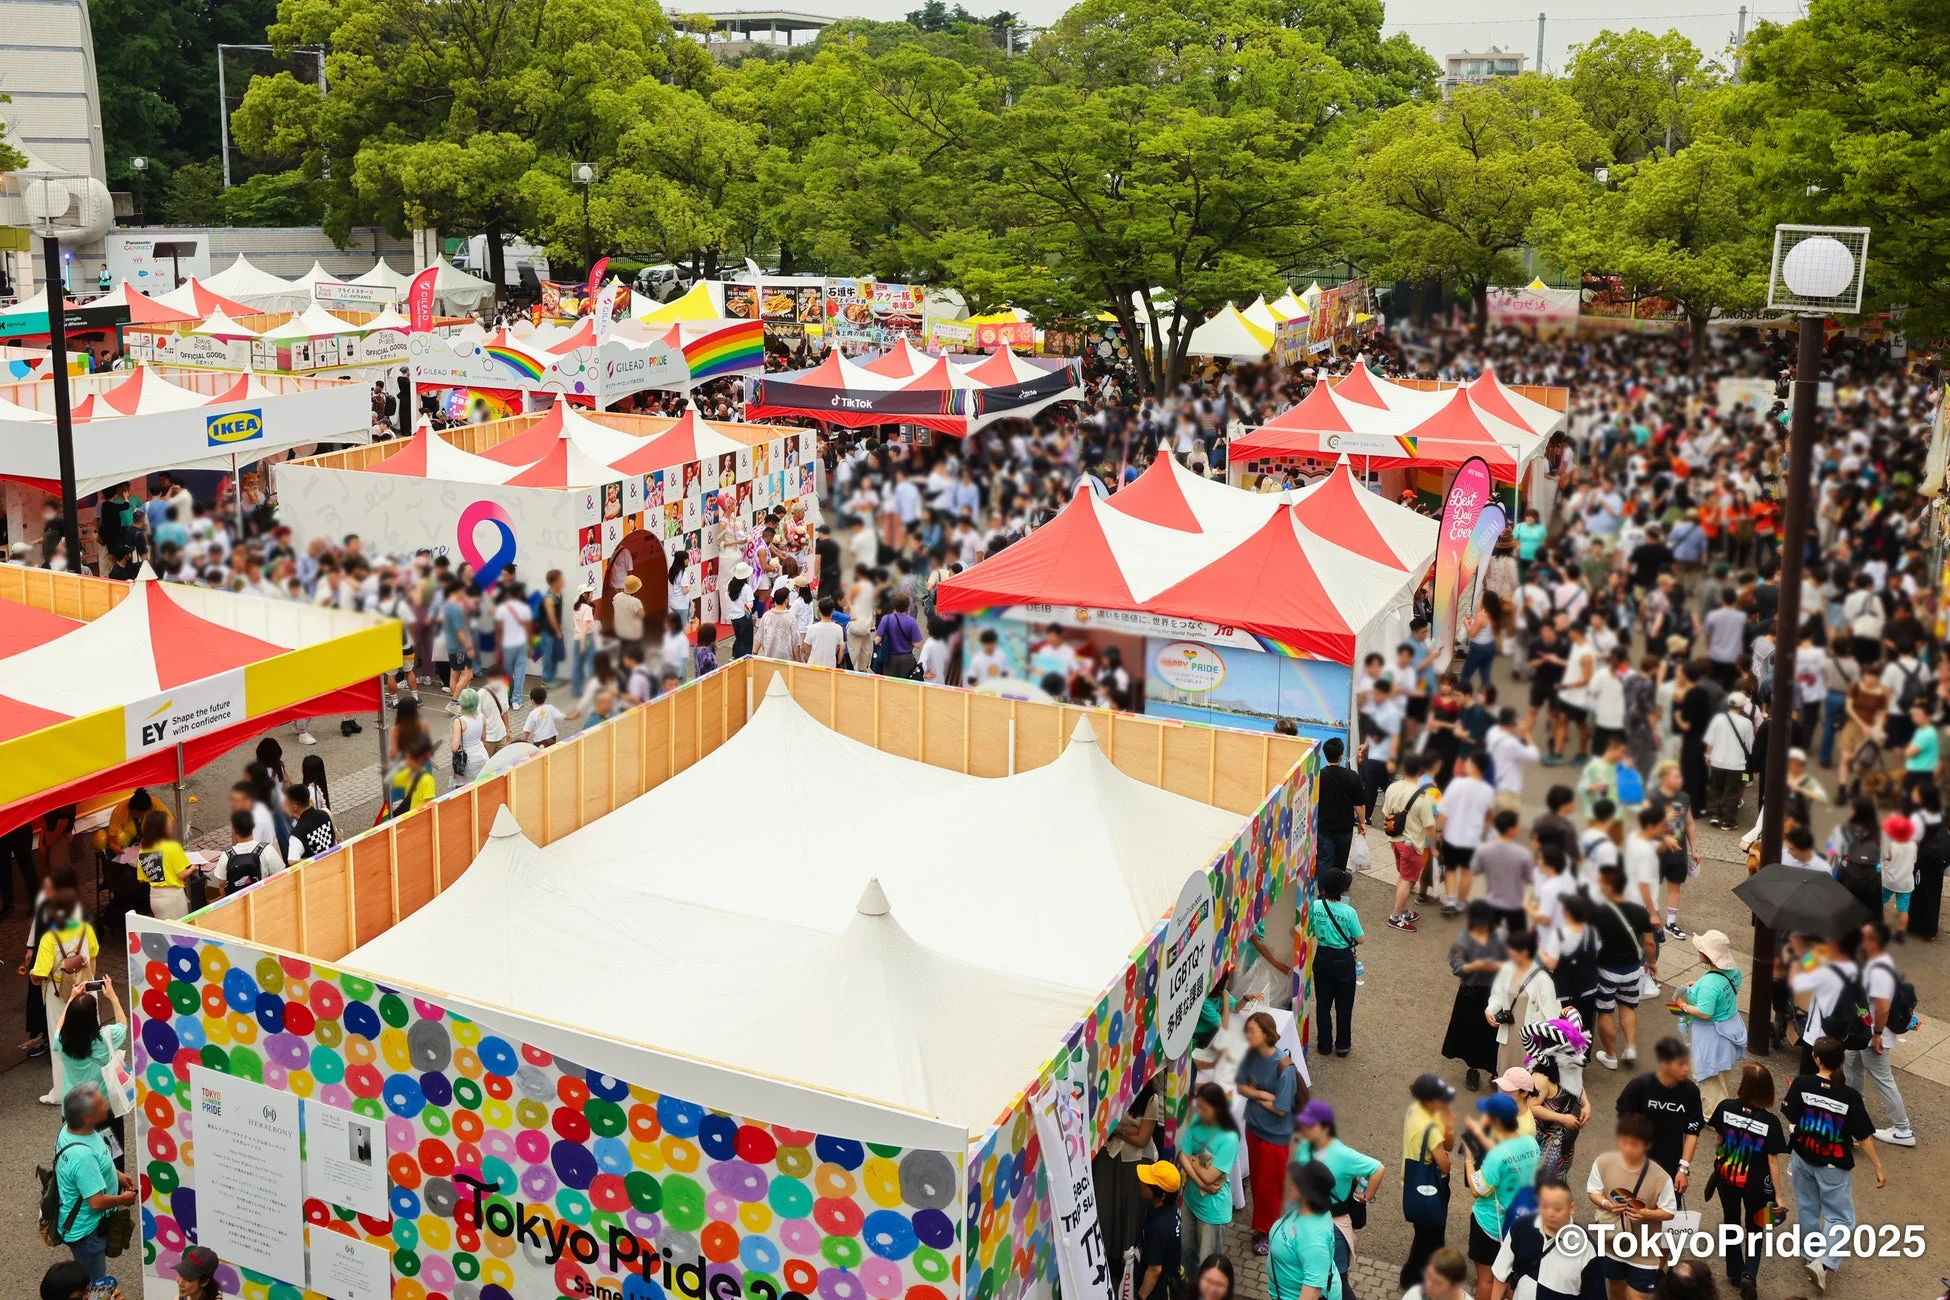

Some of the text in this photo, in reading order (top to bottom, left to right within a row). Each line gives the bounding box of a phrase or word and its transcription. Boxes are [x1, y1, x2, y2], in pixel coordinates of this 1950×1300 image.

[420, 292, 430, 321] GILEAD
[1513, 300, 1546, 312] ロゼ活
[600, 306, 609, 335] GILEAD
[180, 351, 226, 360] OFFICIAL GOODS
[365, 343, 408, 356] OFFICIAL GOODS
[423, 367, 467, 378] GILEAD PRIDE
[616, 355, 667, 373] GILEAD PRIDE
[841, 397, 873, 409] TikTok
[213, 418, 258, 437] IKEA
[1449, 487, 1478, 507] Best
[1453, 506, 1473, 525] Day
[1449, 520, 1472, 540] Ever
[1096, 610, 1208, 632] 違いを価値に、世界をつなぐ。
[1213, 624, 1234, 637] JTB
[1191, 662, 1219, 674] PRIDE
[172, 700, 231, 726] Shape the future
[172, 710, 231, 736] with confidence
[142, 719, 169, 747] EY
[1169, 939, 1205, 1001] LGBTQ+
[1167, 972, 1205, 1041] 多様な課題
[202, 1087, 222, 1101] TOKYO
[202, 1102, 222, 1117] PRIDE
[1647, 1099, 1686, 1113] RVCA
[248, 1118, 293, 1139] HERALBONY
[453, 1173, 600, 1266] Tokyo
